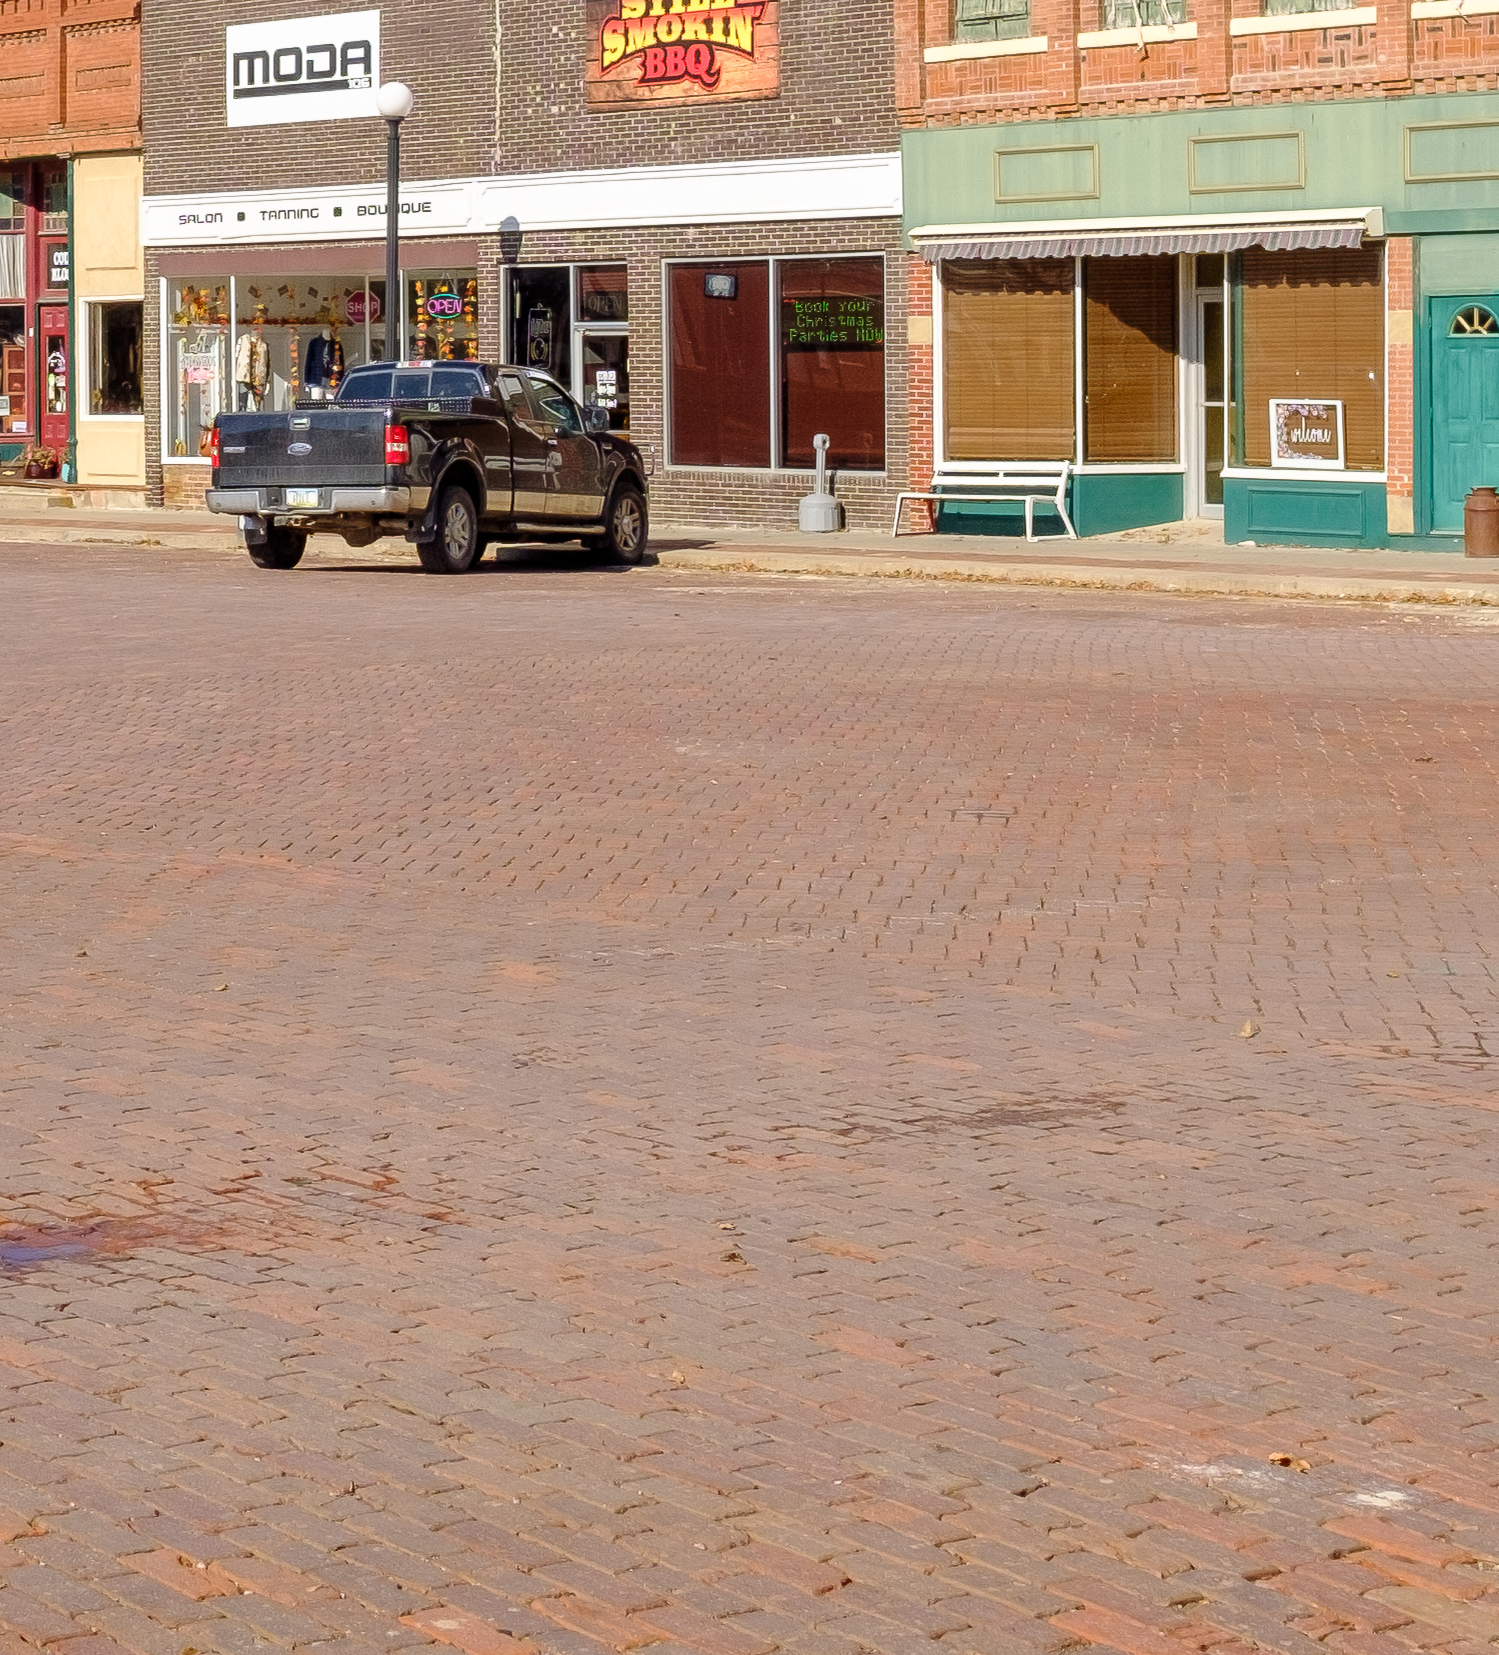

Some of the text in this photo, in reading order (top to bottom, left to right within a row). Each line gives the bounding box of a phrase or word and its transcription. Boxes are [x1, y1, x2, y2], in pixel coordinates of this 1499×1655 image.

[602, 6, 765, 68] SMOKIN'
[233, 39, 372, 86] MODA
[643, 43, 720, 84] BBQ
[178, 201, 433, 225] SALON TANNING BOUIQUE
[427, 299, 462, 314] OPEN
[795, 300, 829, 313] Book
[796, 315, 874, 328] Christmas
[789, 328, 848, 342] Parties
